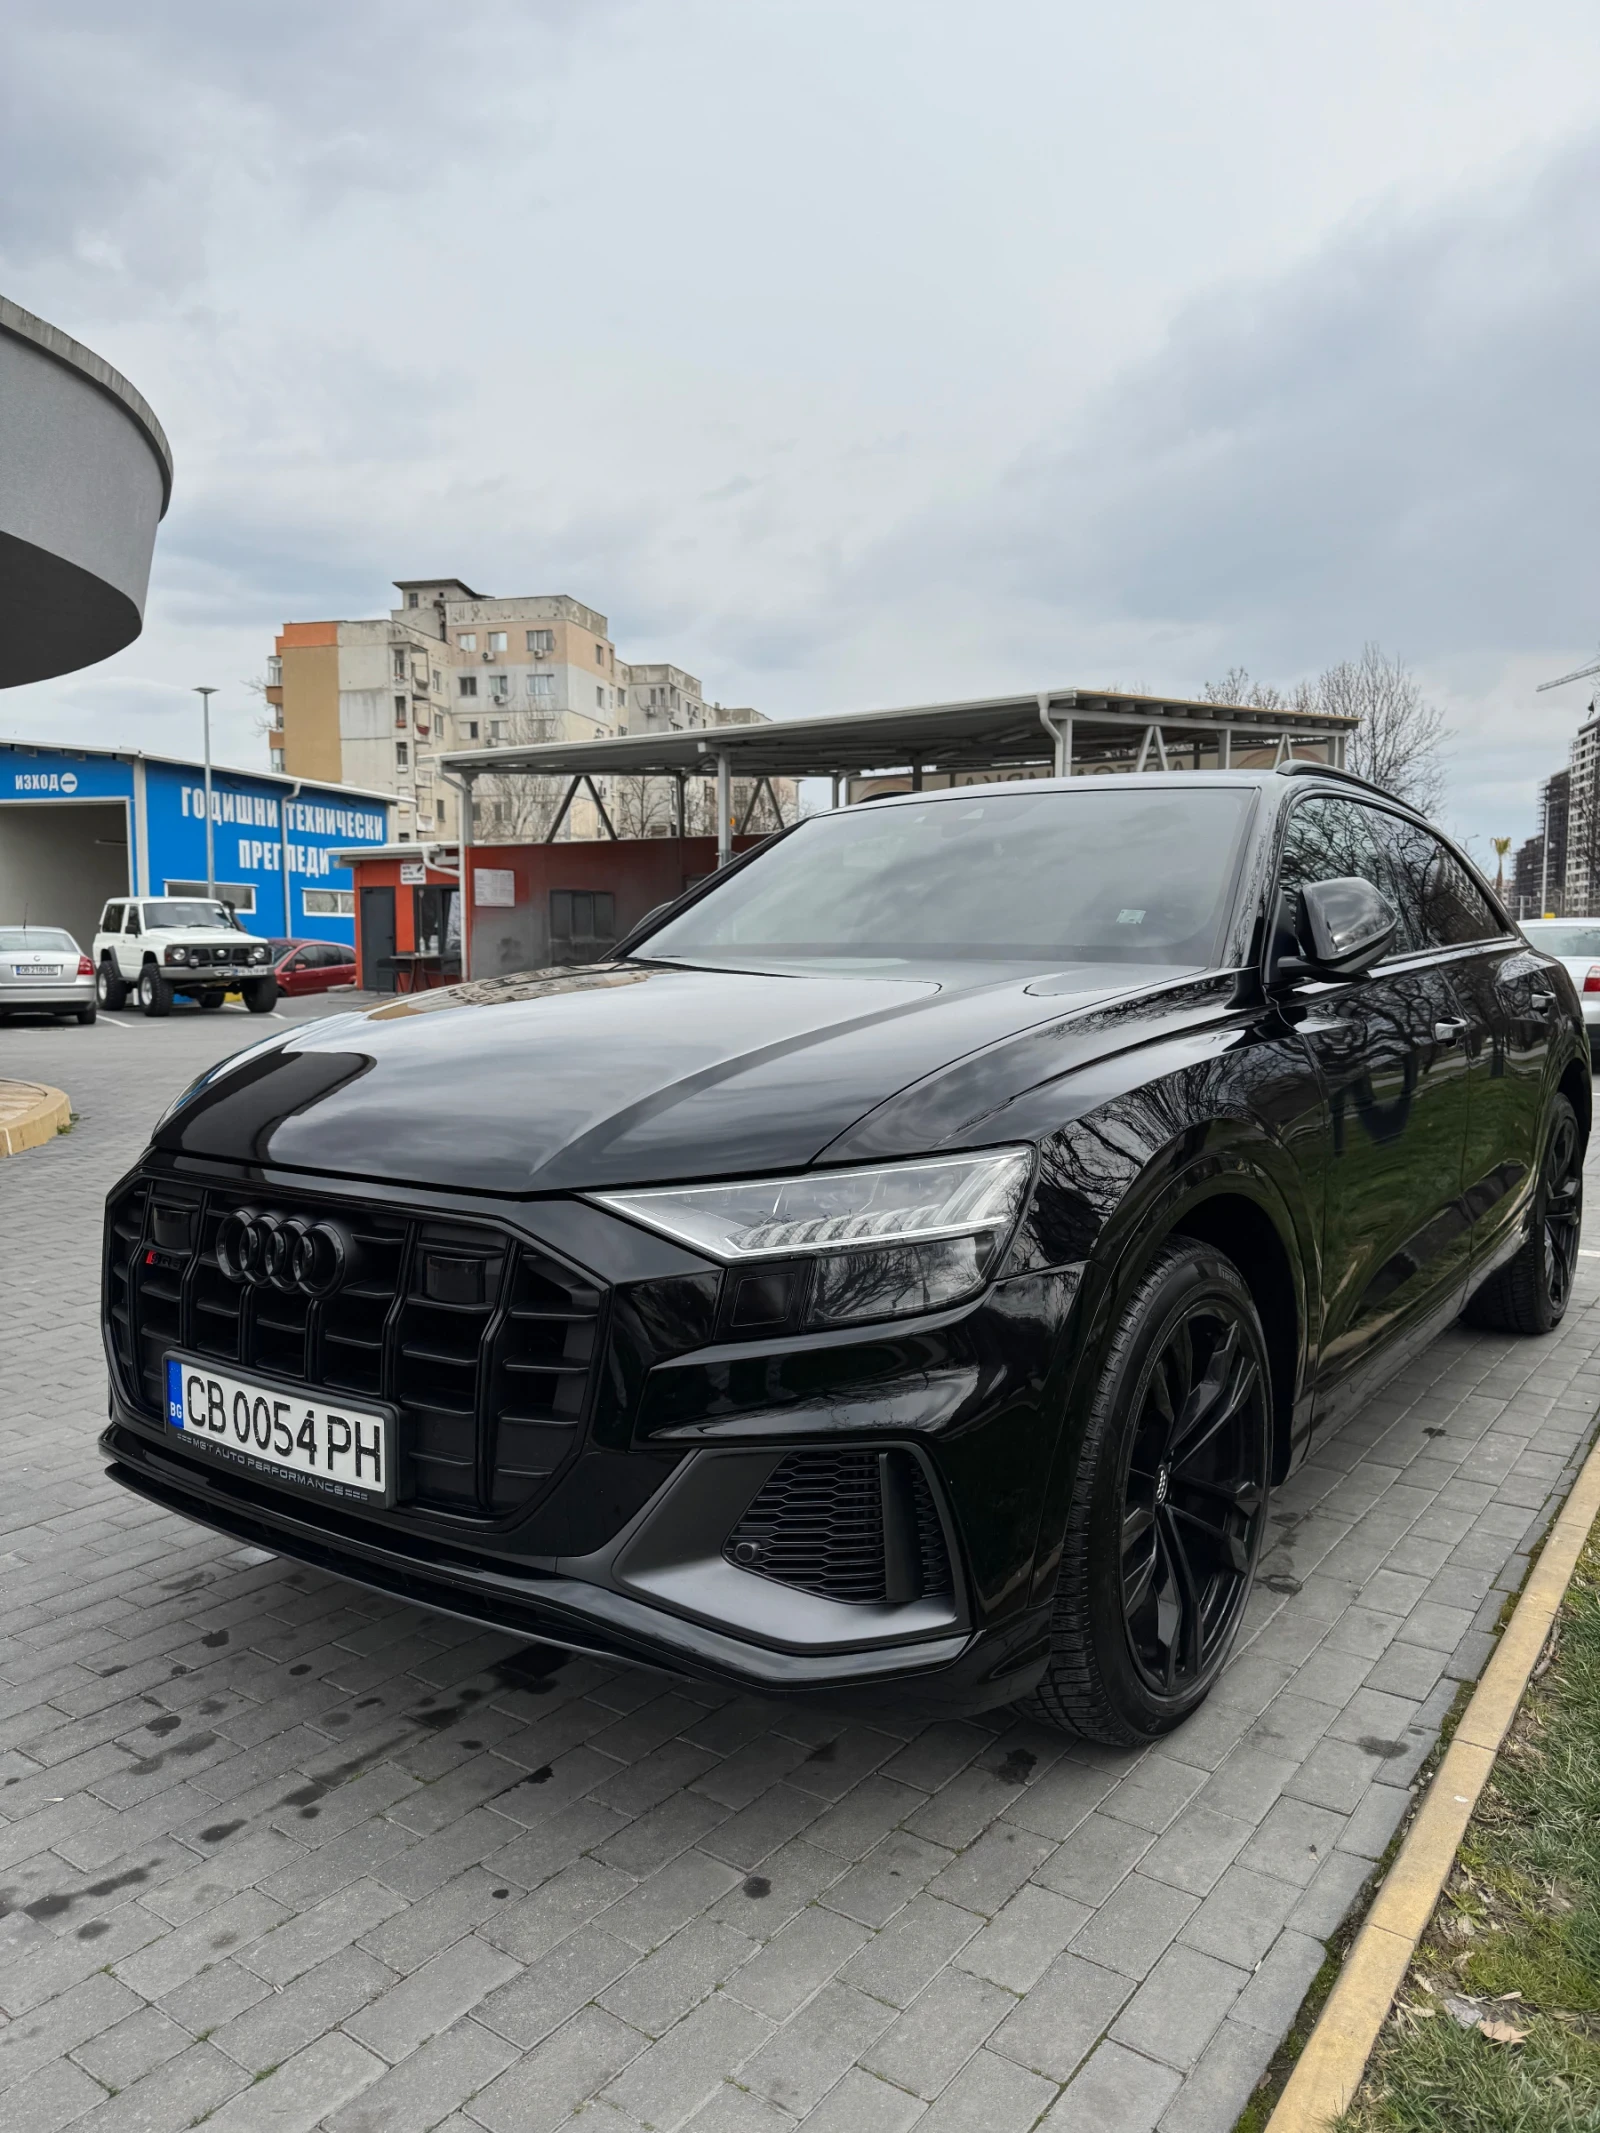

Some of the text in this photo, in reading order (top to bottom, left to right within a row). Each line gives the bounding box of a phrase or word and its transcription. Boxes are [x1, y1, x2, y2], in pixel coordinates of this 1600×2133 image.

[15, 774, 59, 791] ИЗХОД
[181, 786, 383, 841] ГОДИШНИ ТЕХНИЧЕСКИ
[238, 839, 330, 879] ПРЕГЛЕДИ
[170, 1401, 182, 1419] BG
[187, 1375, 381, 1482] CB 0054 PH
[215, 1447, 245, 1465] AUTO
[247, 1457, 344, 1495] PERFORMANCE
